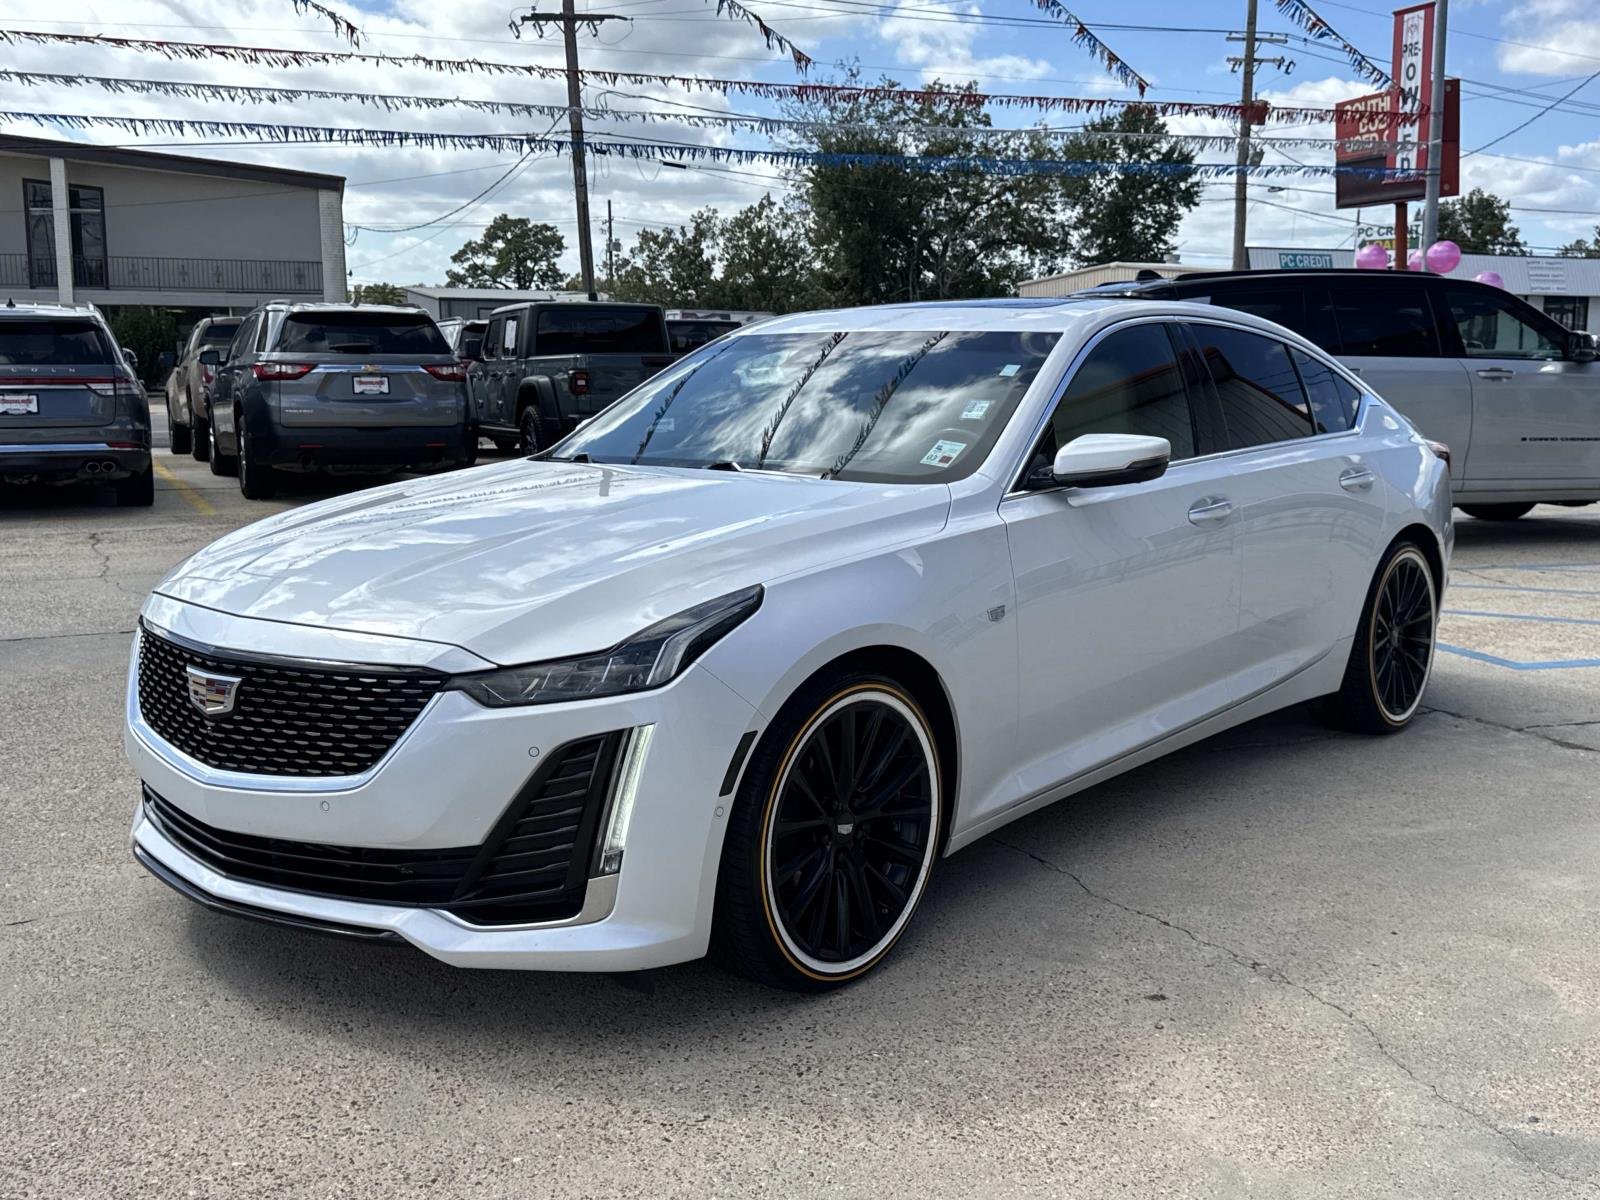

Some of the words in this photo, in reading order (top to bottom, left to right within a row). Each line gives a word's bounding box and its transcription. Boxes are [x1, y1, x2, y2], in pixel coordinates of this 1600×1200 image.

[1357, 227, 1373, 238] PC
[1281, 254, 1294, 267] PC
[1296, 255, 1330, 268] CREDIT
